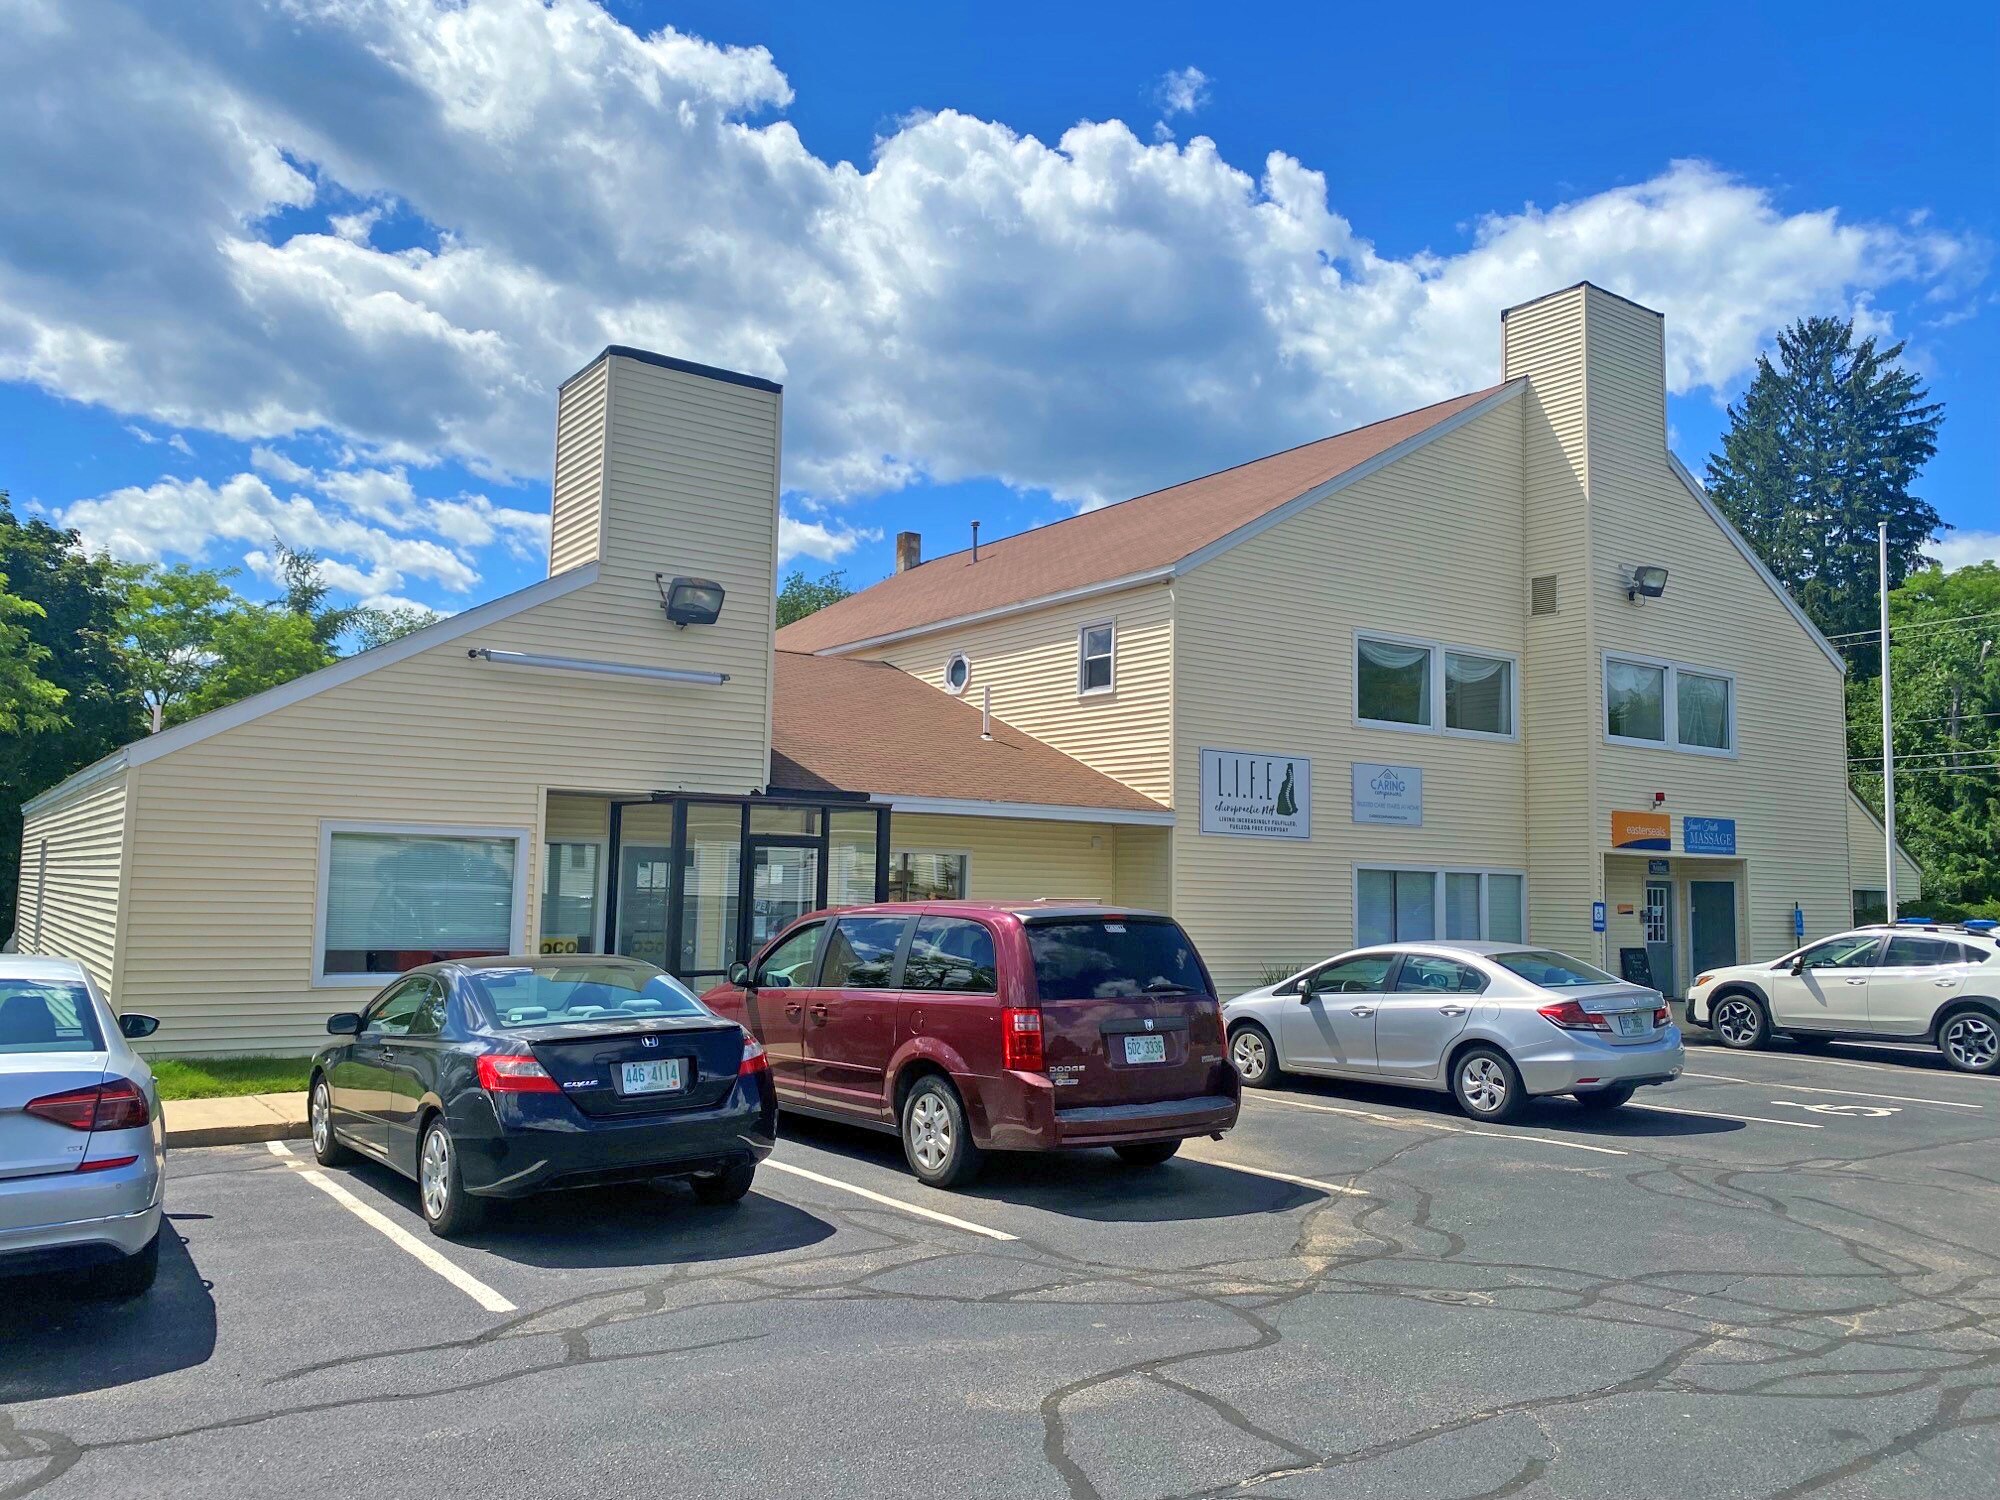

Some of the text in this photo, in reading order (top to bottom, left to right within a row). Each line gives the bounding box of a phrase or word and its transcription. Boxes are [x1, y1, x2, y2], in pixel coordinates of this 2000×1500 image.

[1370, 778, 1406, 792] CARING
[1236, 817, 1271, 825] INCREASINGLY
[1251, 824, 1264, 832] FREE
[1264, 825, 1289, 833] EVERYDAY
[1626, 824, 1667, 837] easterseals
[1689, 831, 1733, 846] MASSAGE
[1127, 1041, 1142, 1056] 502
[625, 1064, 678, 1084] 446 4114
[1049, 1064, 1086, 1073] DODGE
